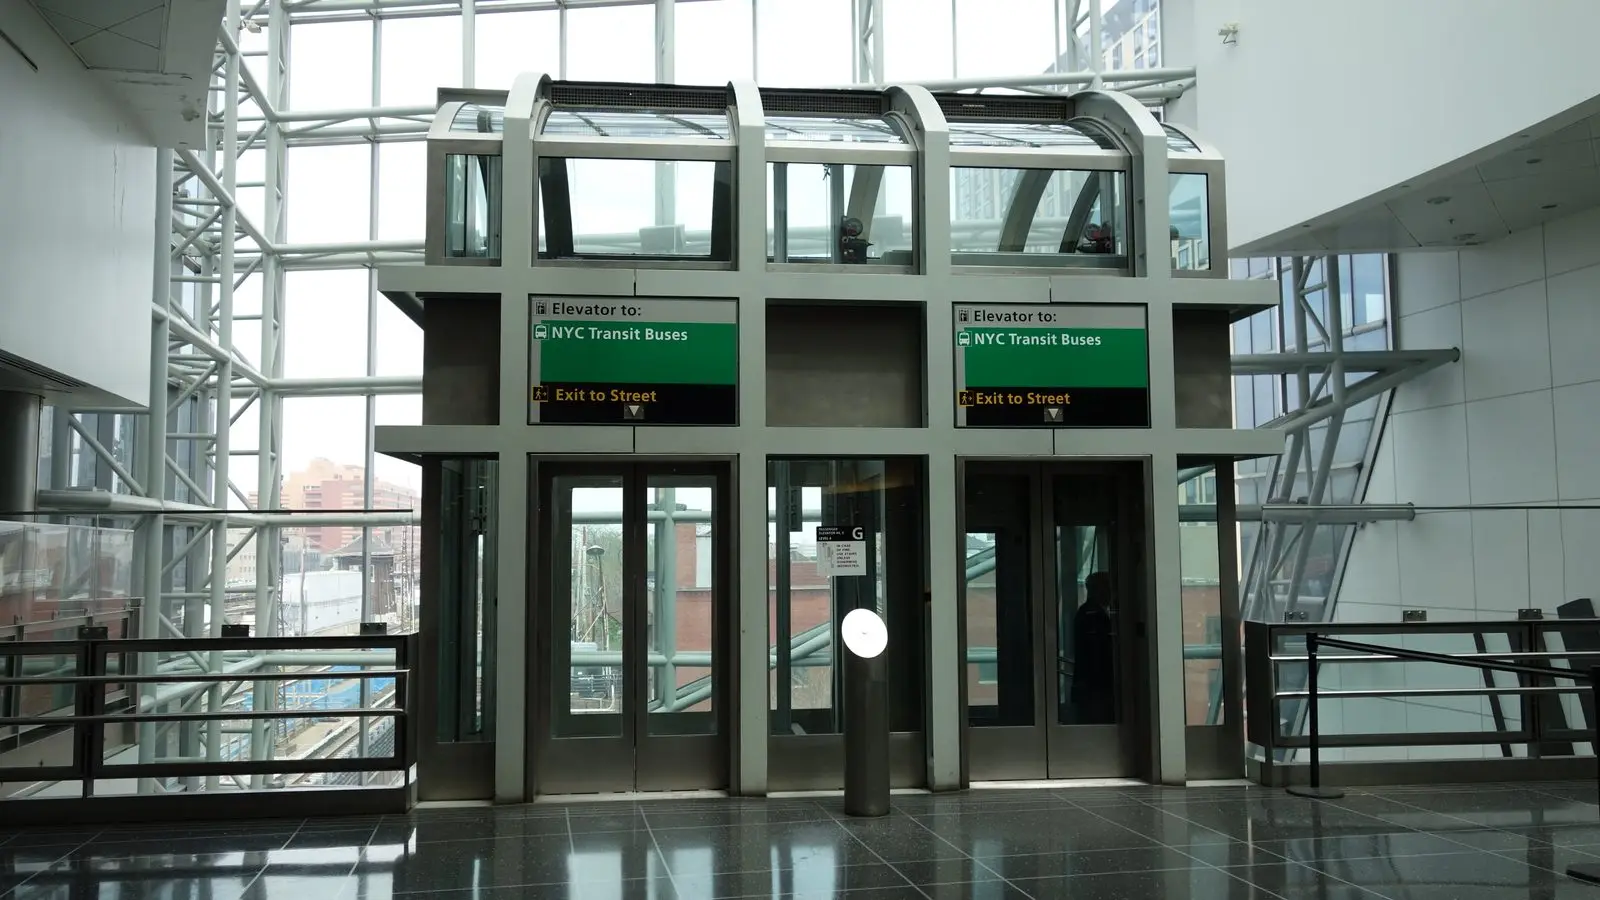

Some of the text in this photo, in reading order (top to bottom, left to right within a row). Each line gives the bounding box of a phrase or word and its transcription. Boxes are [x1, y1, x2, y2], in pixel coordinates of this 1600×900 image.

[552, 303, 642, 316] Elevator to:
[974, 310, 1057, 322] Elevator to:
[552, 327, 688, 341] NYC Transit Buses
[974, 333, 1101, 346] NYC Transit Buses
[556, 389, 657, 402] Exit to Street
[976, 392, 1071, 405] Exit to Street
[852, 527, 864, 540] G
